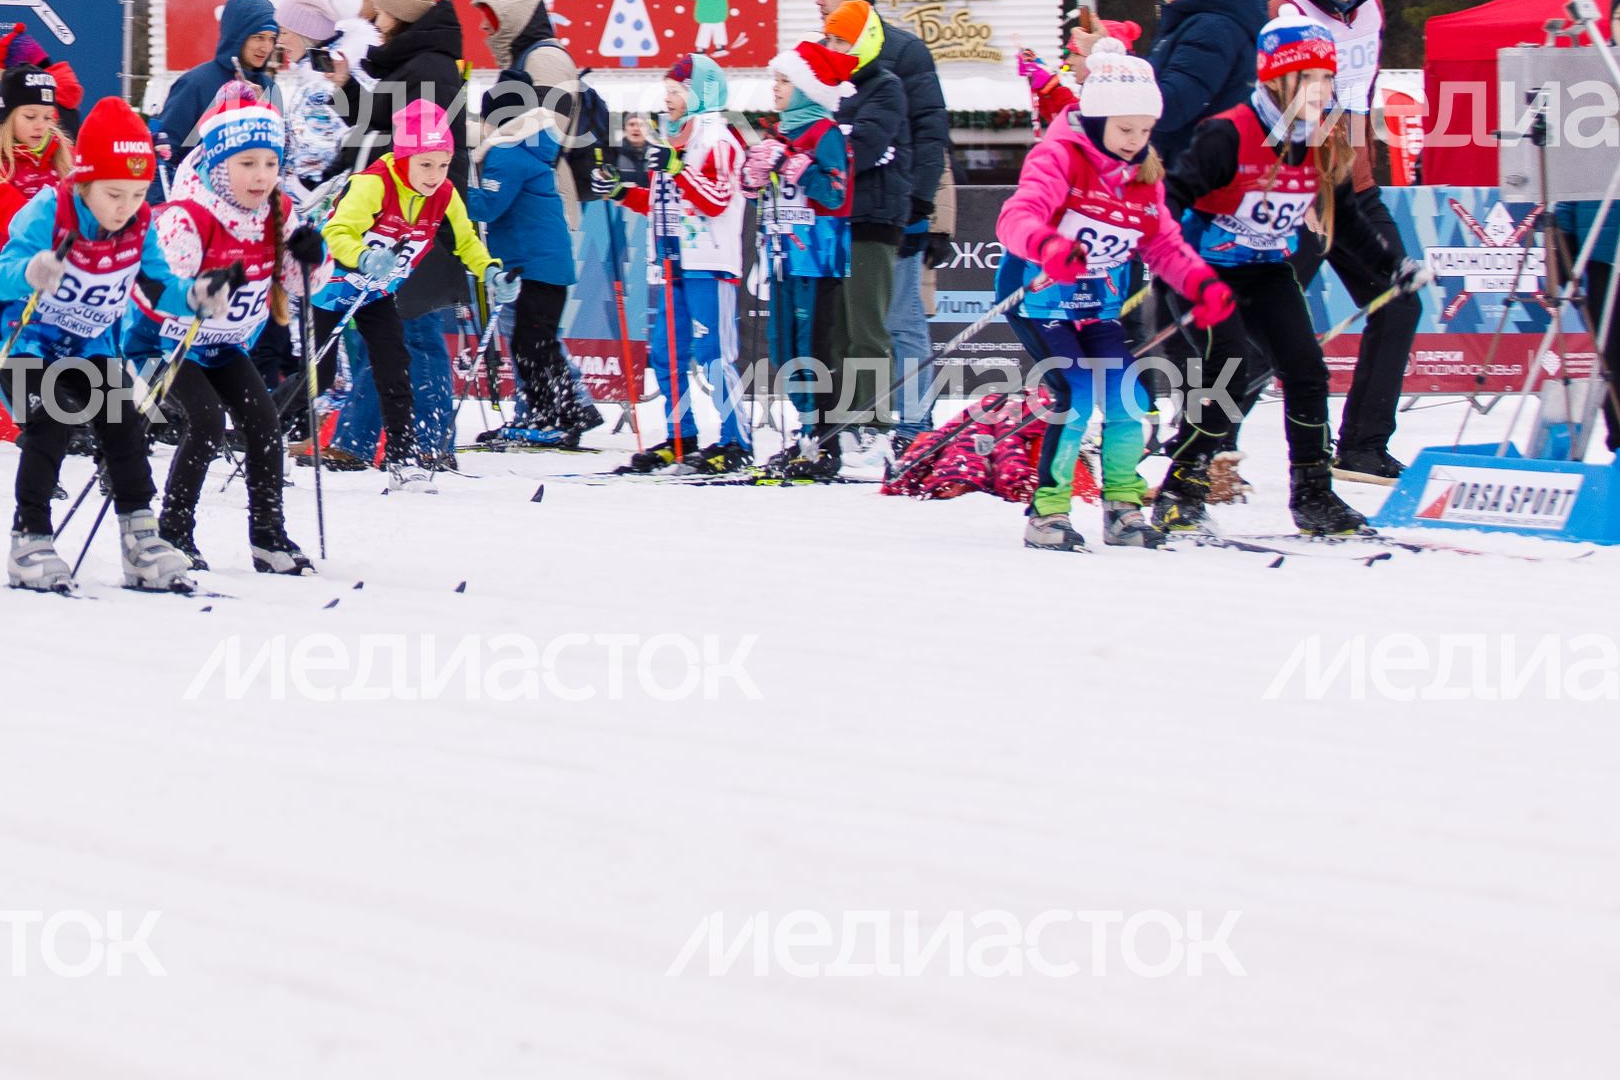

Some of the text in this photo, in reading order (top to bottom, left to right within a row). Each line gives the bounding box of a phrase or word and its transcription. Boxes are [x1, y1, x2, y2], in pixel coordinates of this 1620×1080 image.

[227, 290, 266, 322] 56
[1416, 351, 1464, 362] ПАРКИ
[1451, 482, 1575, 516] ORSA SPORT
